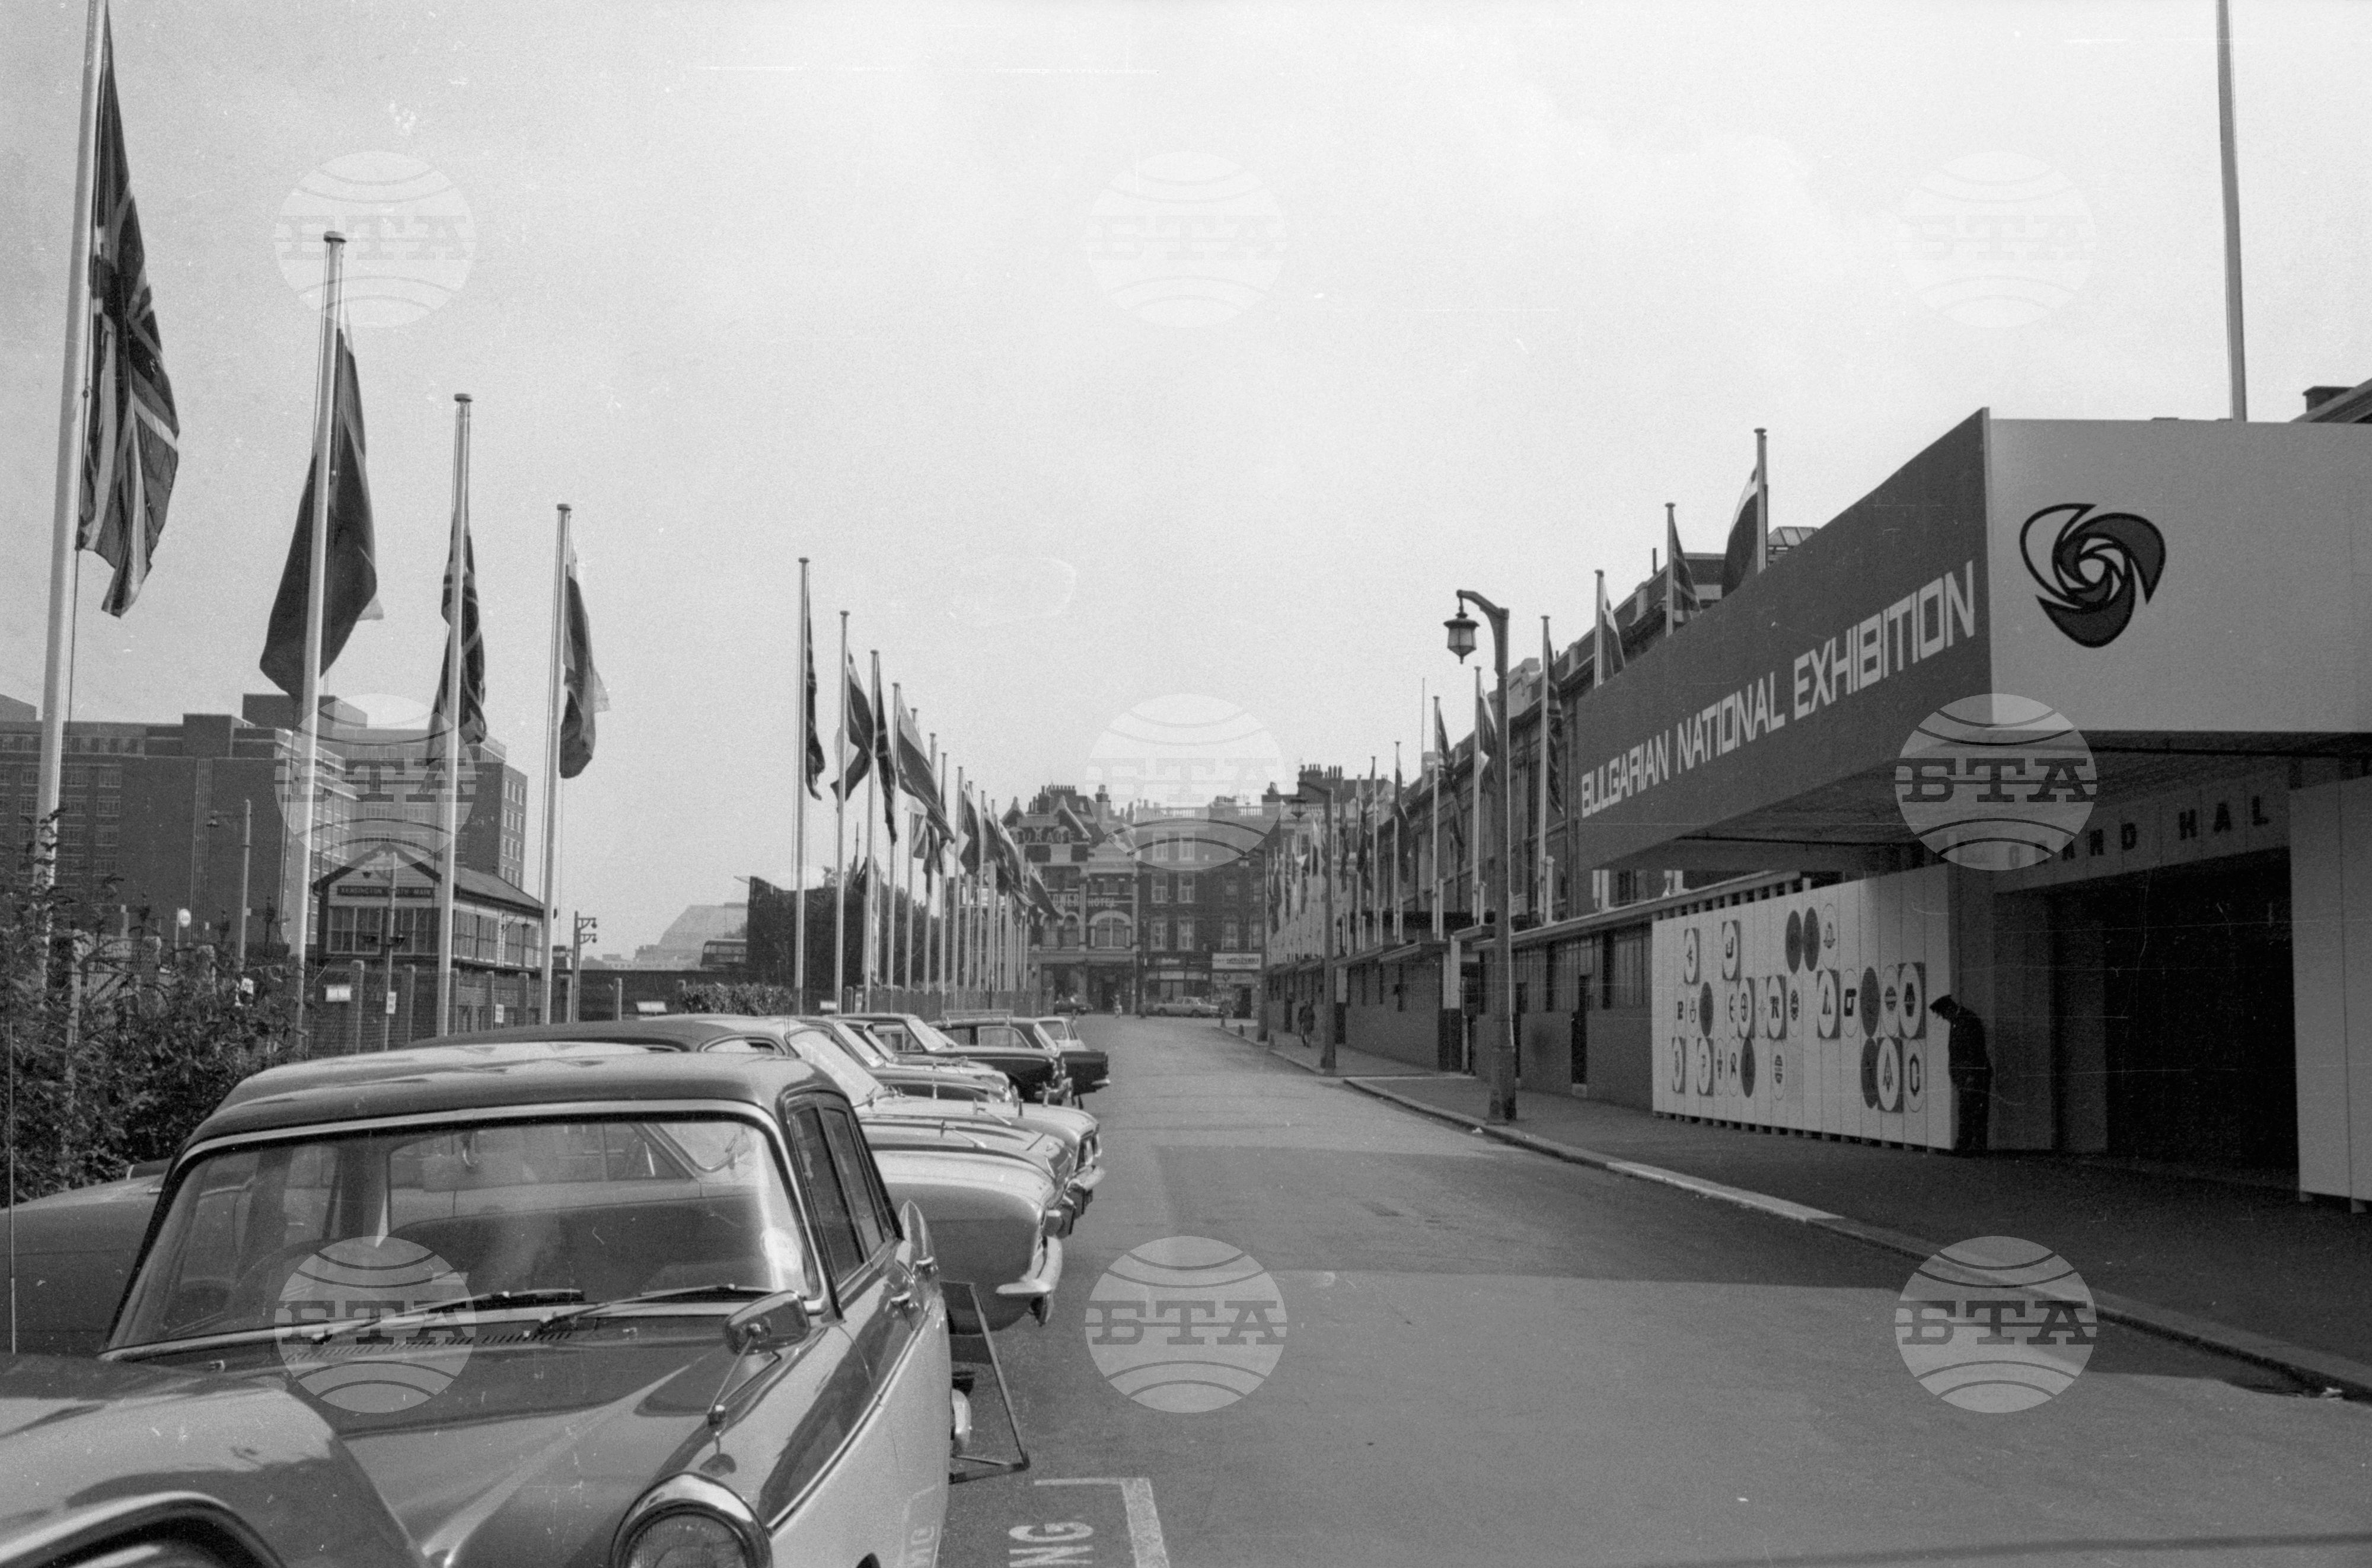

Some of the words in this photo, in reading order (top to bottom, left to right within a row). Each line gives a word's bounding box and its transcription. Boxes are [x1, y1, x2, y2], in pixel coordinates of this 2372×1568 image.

[1582, 730, 1669, 818] BULGARIAN
[1677, 672, 1786, 774] NATIONAL
[1794, 560, 1975, 720] EXHIBITION
[2179, 796, 2269, 841] HAL
[1011, 830, 1076, 844] OURAGE
[1088, 897, 1115, 907] HOTEL
